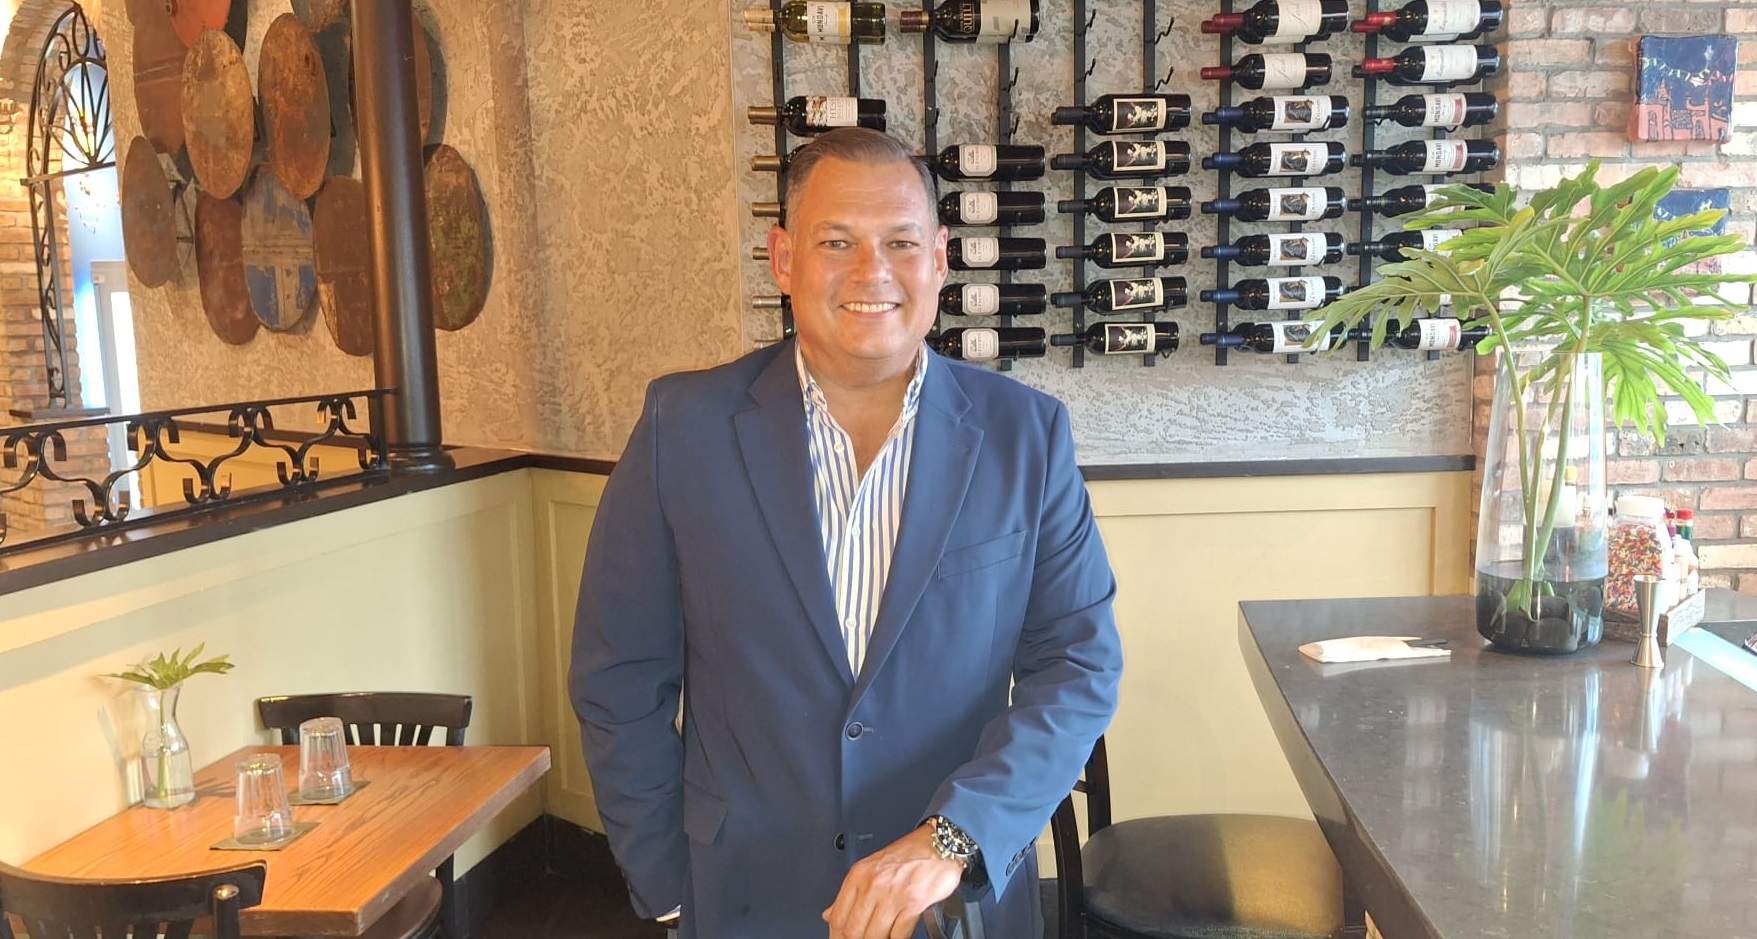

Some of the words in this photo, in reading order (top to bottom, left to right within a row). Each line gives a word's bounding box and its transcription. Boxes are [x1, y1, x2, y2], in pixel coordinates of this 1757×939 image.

[816, 5, 824, 33] MONDAVI
[963, 3, 973, 33] QUILT
[1434, 142, 1442, 168] MONDAVI
